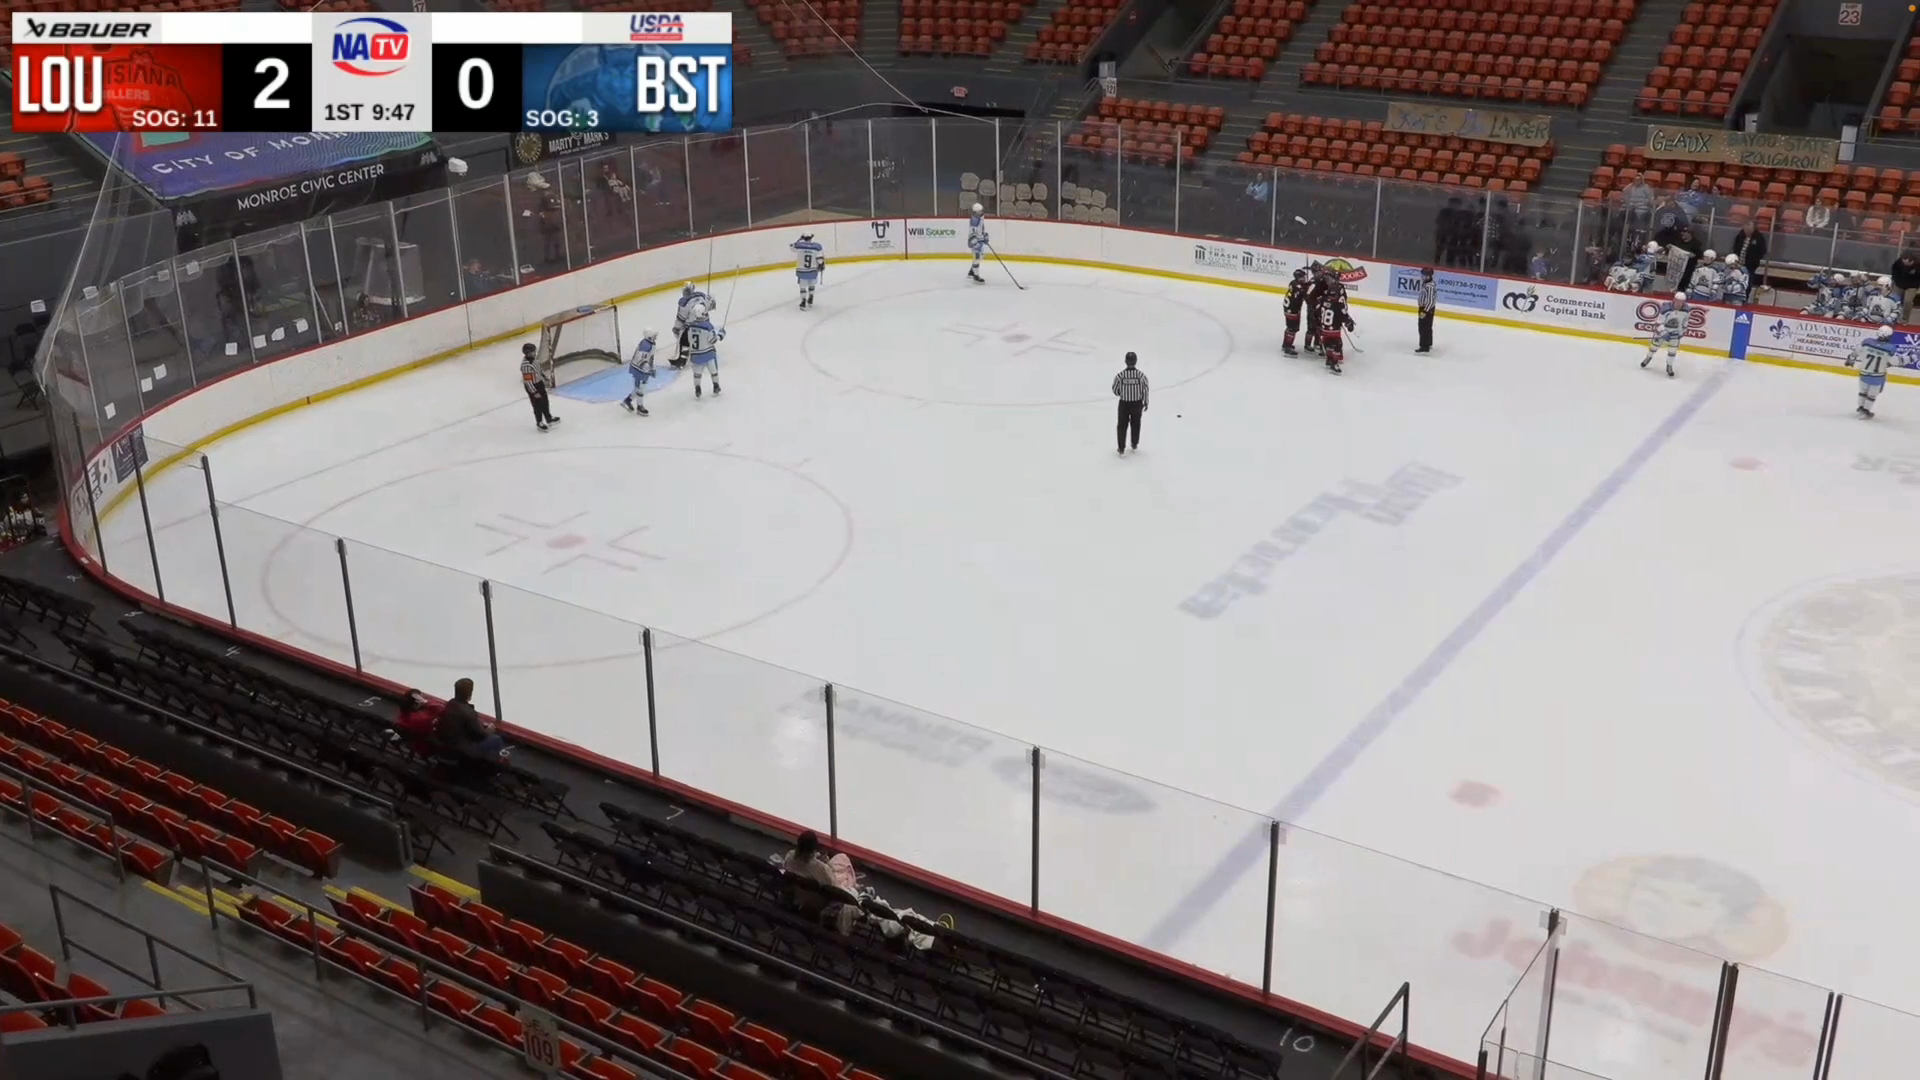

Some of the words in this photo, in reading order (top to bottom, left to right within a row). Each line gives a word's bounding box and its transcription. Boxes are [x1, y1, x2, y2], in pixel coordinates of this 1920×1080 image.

[1840, 10, 1860, 24] 23
[548, 137, 574, 153] MARTY
[1650, 129, 1713, 154] GEAUX
[152, 154, 214, 175] CITY
[224, 145, 260, 162] OF
[236, 183, 298, 211] MONROE
[300, 175, 336, 195] CIVIC
[338, 164, 385, 185] CENTER
[908, 227, 925, 236] Will
[926, 228, 956, 236] Source
[803, 254, 813, 268] 9
[1208, 251, 1238, 260] TRASH
[1256, 258, 1287, 266] TRASH
[1546, 295, 1606, 310] Commercial
[1543, 304, 1579, 317] Capital
[1581, 309, 1606, 320] Bank
[1796, 322, 1862, 337] ADVANCED
[691, 333, 700, 350] 3
[1796, 338, 1825, 347] HEARING
[1806, 333, 1842, 343] AUDIOLOGY
[1865, 353, 1882, 373] 71
[665, 804, 684, 820] 7
[1279, 1027, 1315, 1053] 10
[524, 1031, 555, 1066] 109
